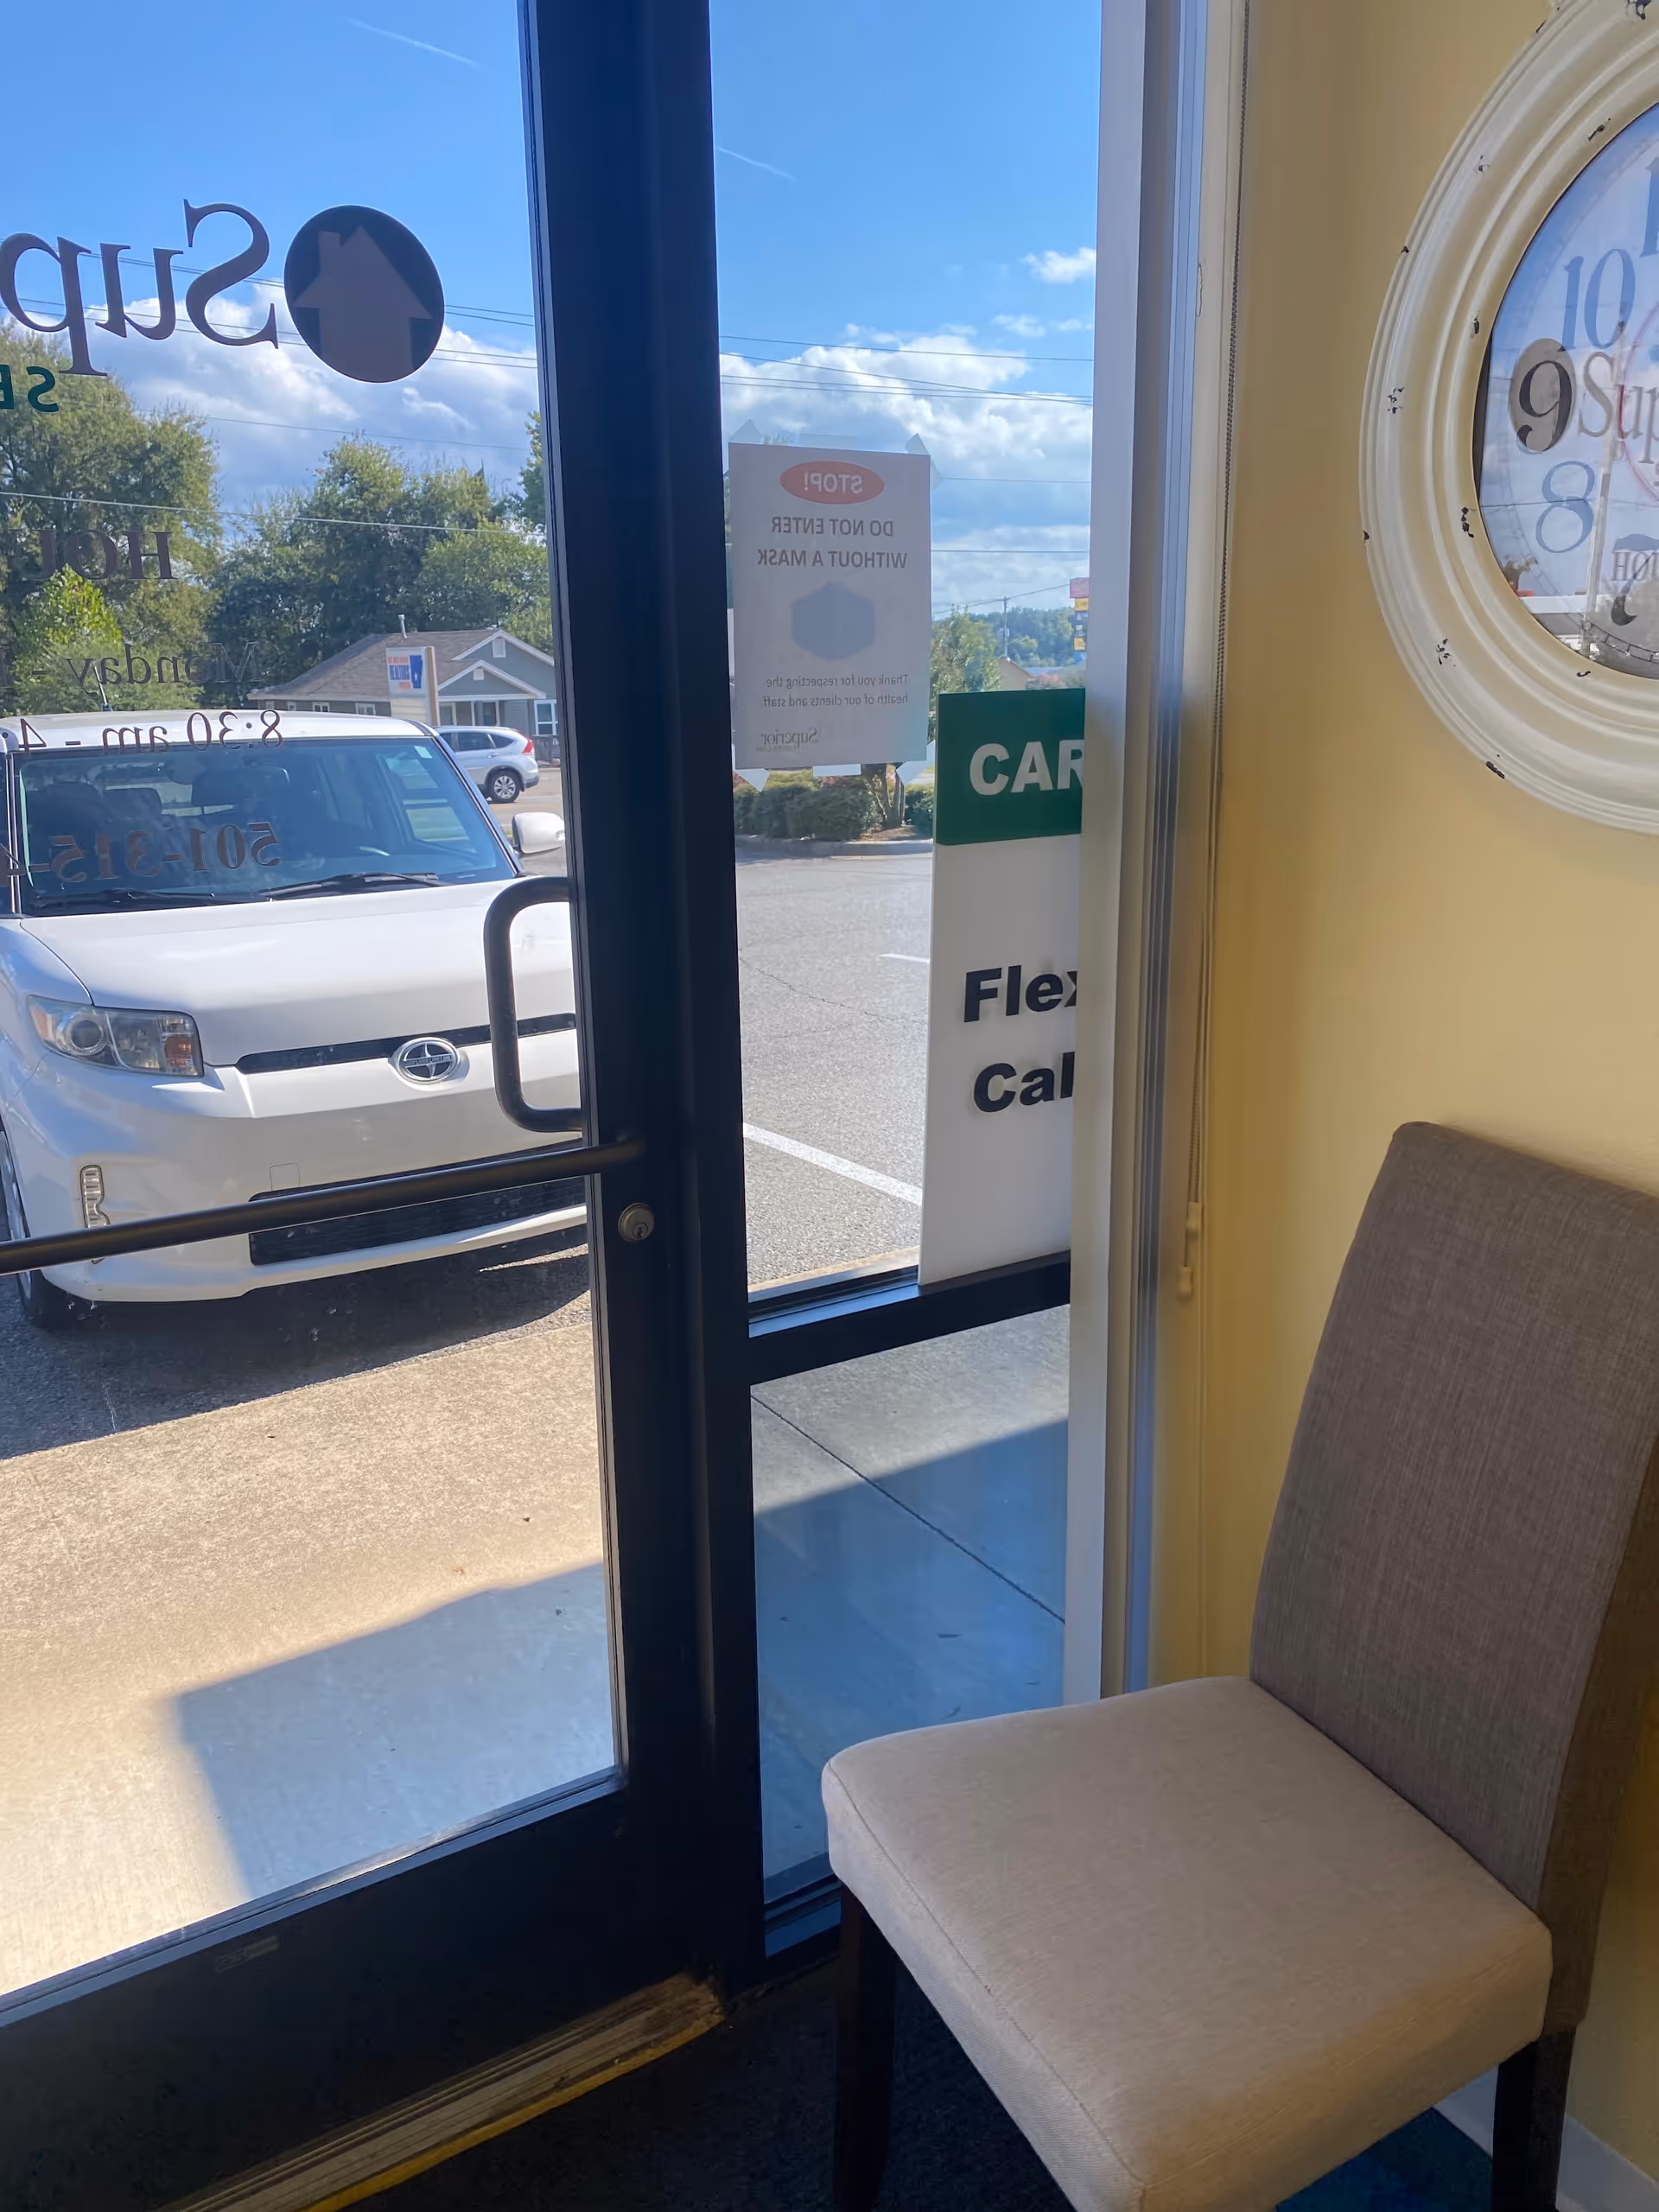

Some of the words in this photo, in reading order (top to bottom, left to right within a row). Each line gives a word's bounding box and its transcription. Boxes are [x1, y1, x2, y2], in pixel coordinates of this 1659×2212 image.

[1557, 248, 1636, 353] 10
[1516, 360, 1573, 454] 9
[1535, 461, 1596, 553] 8
